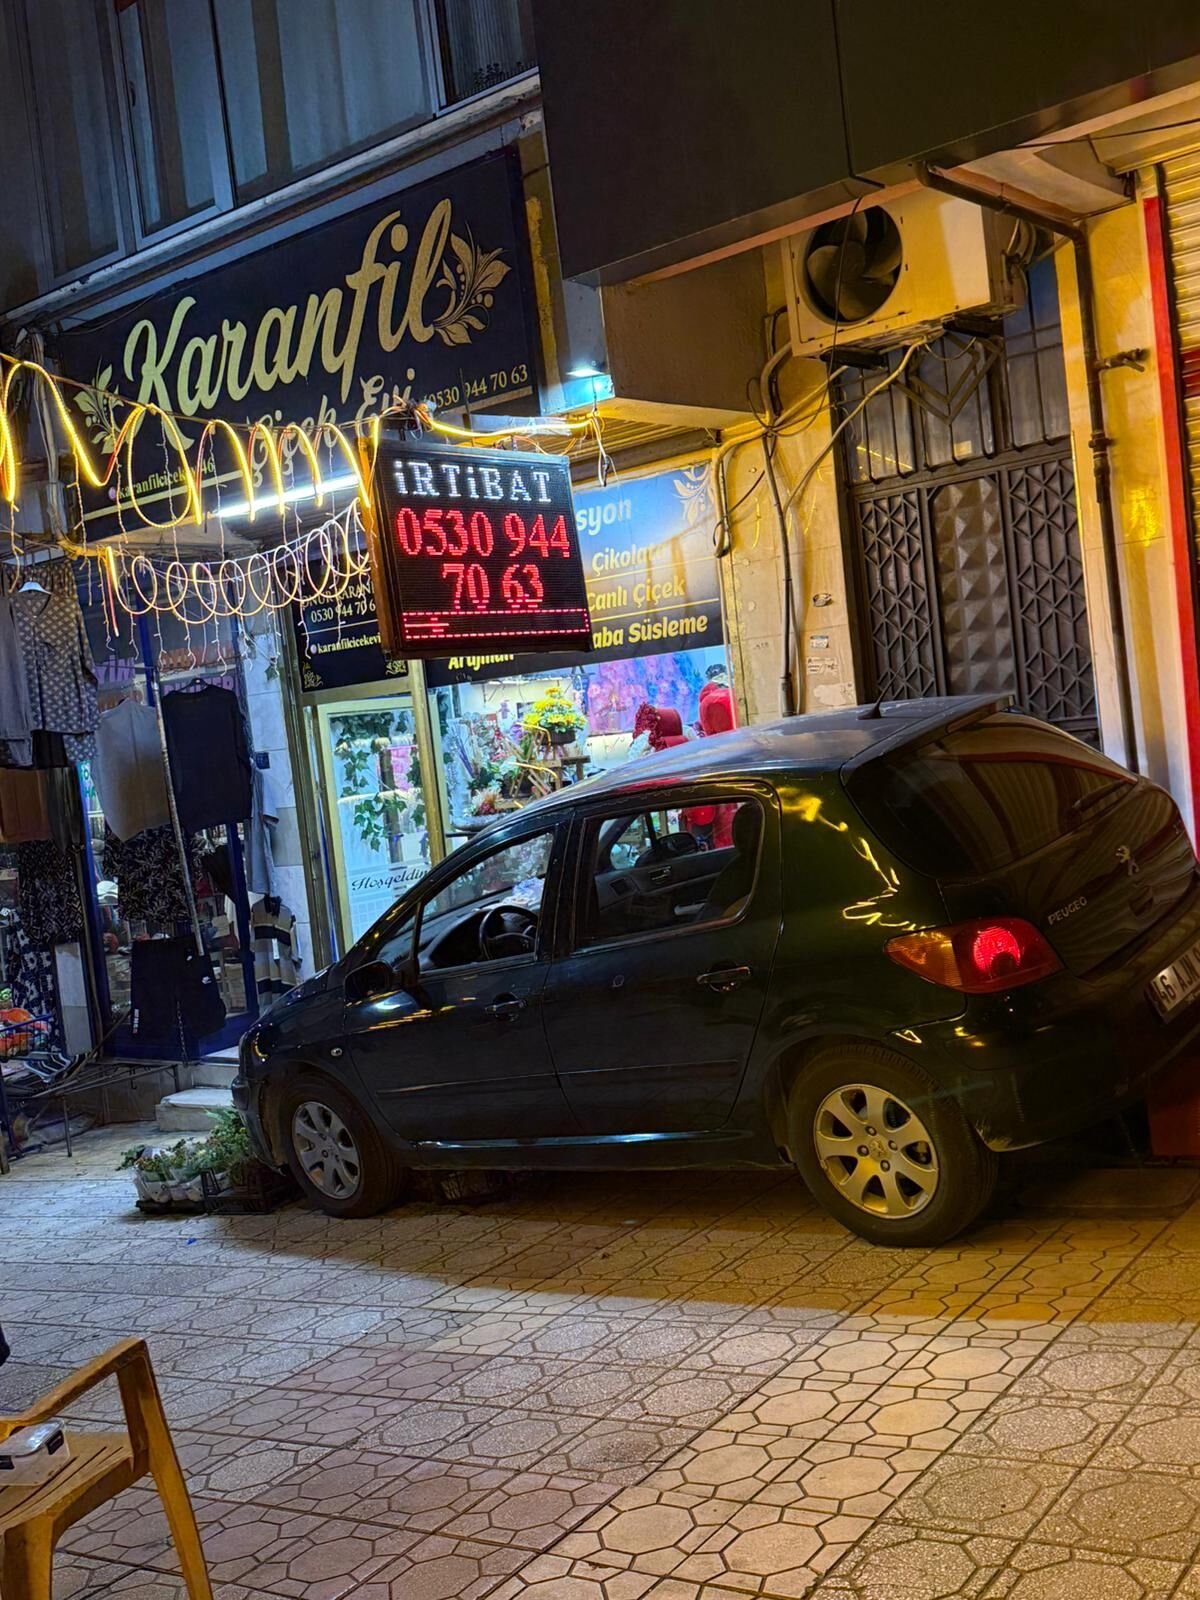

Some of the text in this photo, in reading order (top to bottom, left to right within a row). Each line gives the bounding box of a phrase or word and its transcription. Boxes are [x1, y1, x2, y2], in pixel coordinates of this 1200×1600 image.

[124, 198, 452, 451] Karanfil
[490, 370, 507, 392] 70
[511, 364, 528, 384] 63
[396, 507, 570, 558] 0530 944
[441, 563, 544, 609] 70 63
[633, 575, 685, 608] Çiçek
[311, 607, 334, 622] 0530
[335, 604, 353, 618] 944
[369, 599, 376, 612] 6
[629, 615, 708, 643] Süsleme
